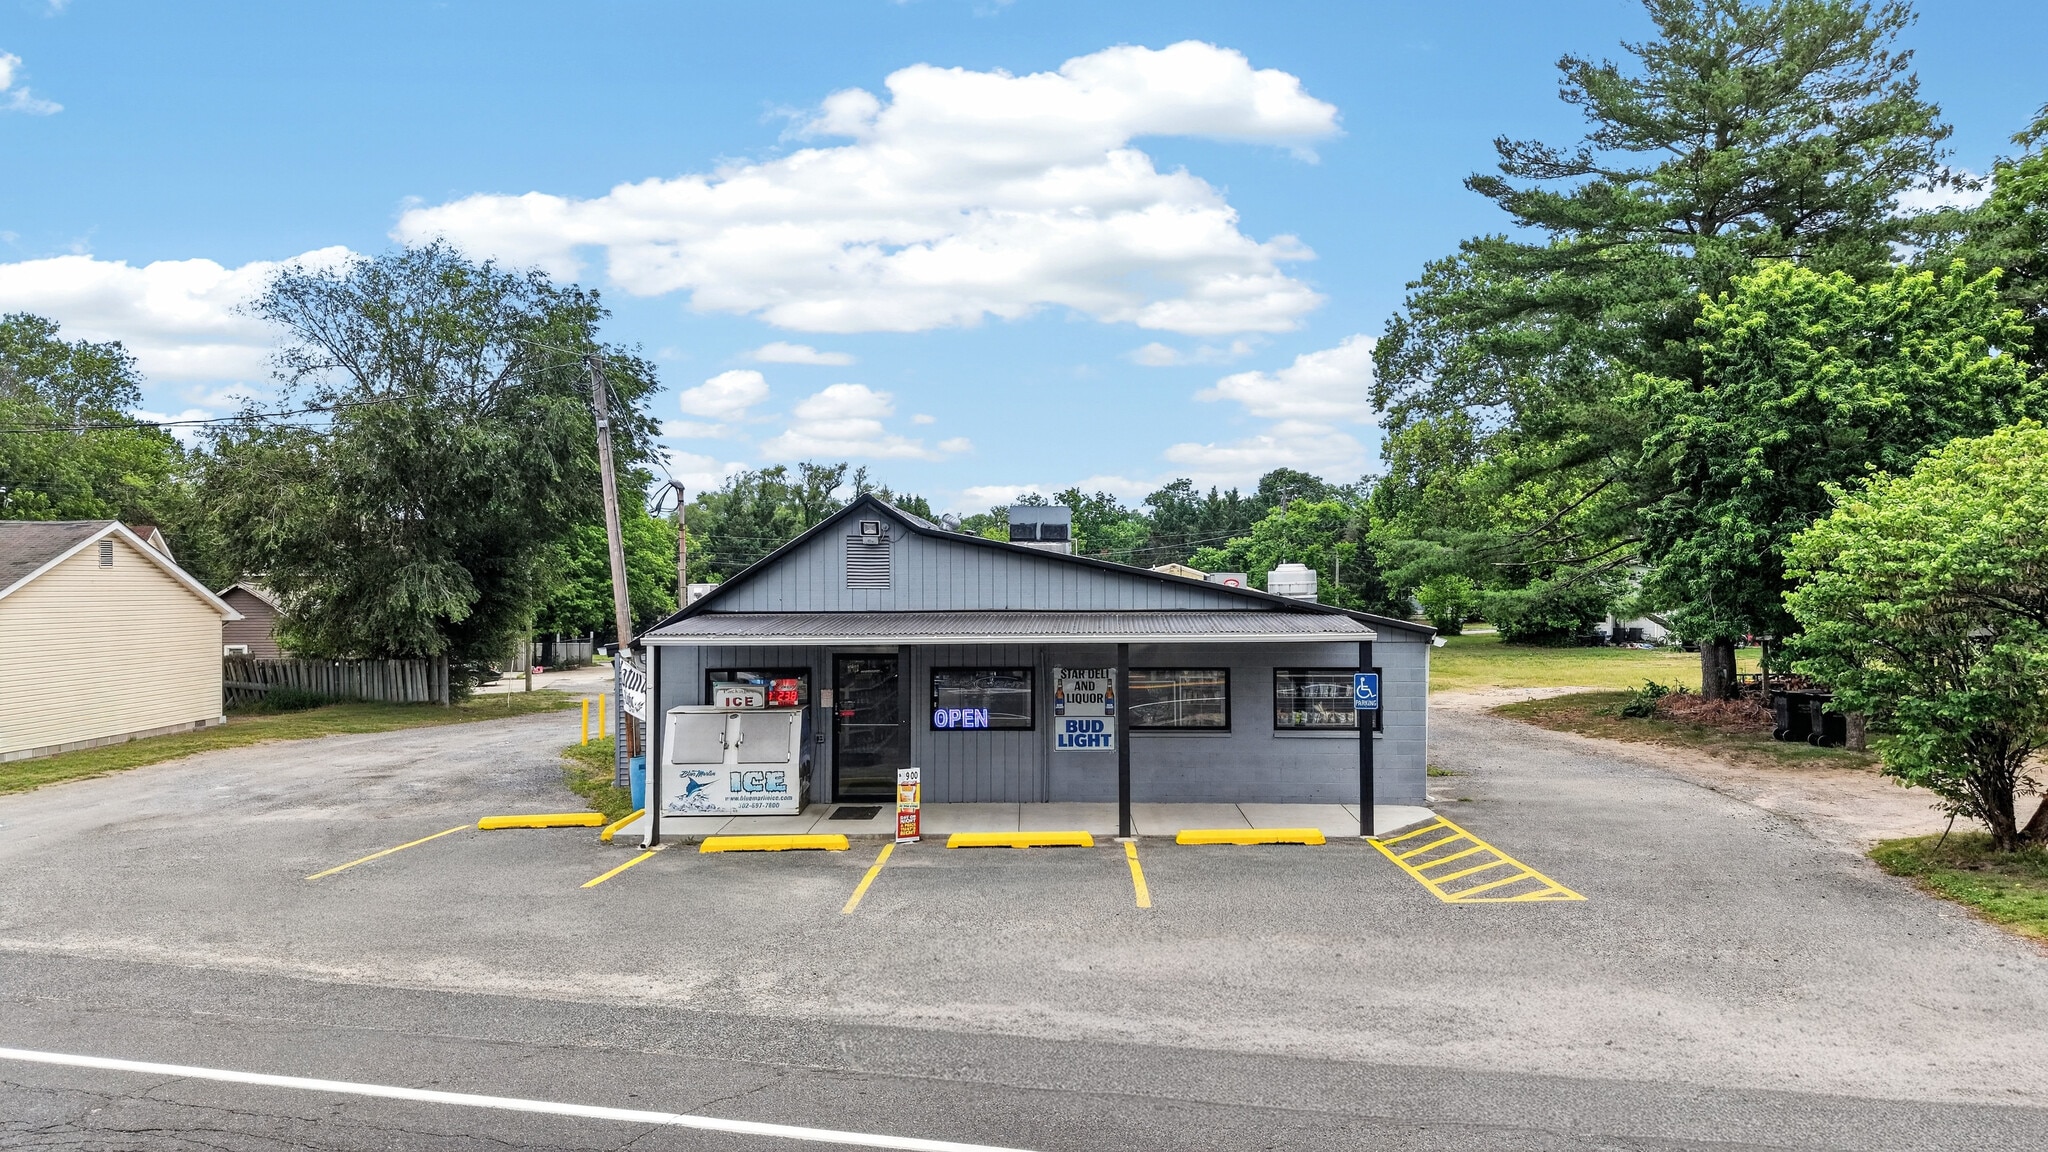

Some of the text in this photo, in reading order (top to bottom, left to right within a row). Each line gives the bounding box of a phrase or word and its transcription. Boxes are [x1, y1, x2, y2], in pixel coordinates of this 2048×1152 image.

[1060, 668, 1110, 680] STAR DELI
[1074, 681, 1095, 691] AND
[726, 696, 754, 707] ICE
[1066, 693, 1104, 705] LIQUOR
[934, 708, 988, 728] OPEN
[1065, 719, 1105, 733] BUD
[1058, 733, 1112, 747] LIGHT
[729, 770, 788, 793] ICE
